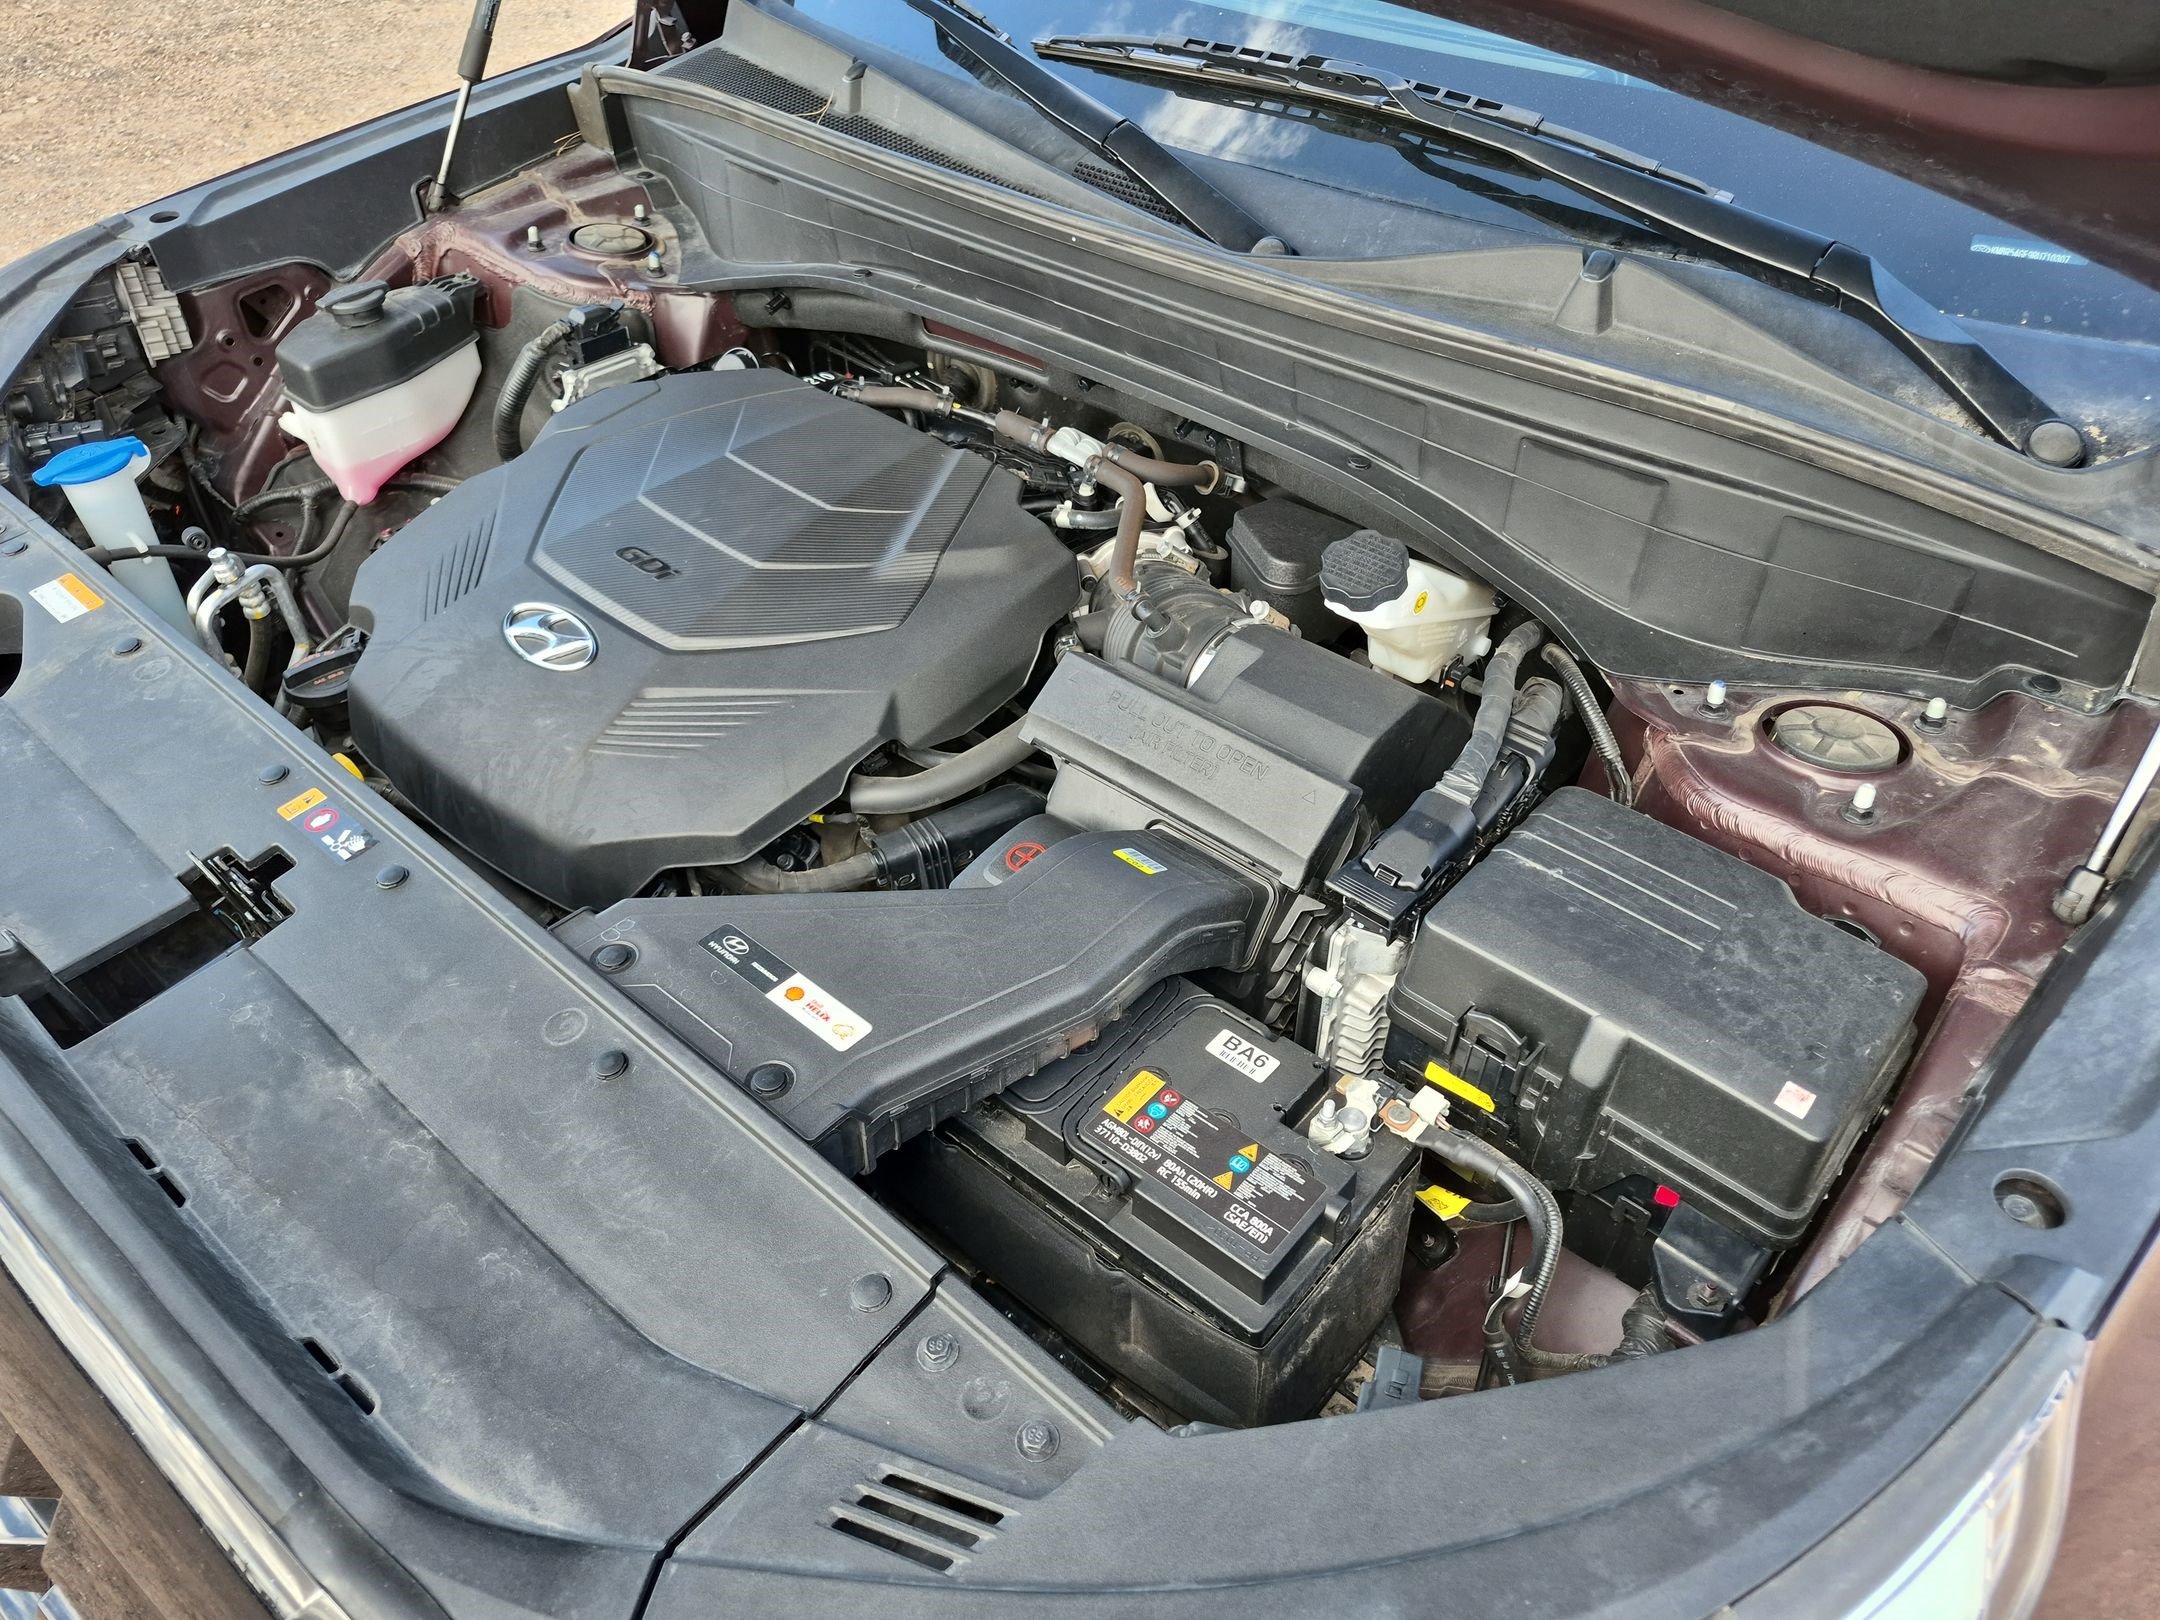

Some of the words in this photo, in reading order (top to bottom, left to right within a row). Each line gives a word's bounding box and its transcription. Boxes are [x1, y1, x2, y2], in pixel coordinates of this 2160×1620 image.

[615, 546, 681, 580] GDi
[1109, 689, 1146, 722] PULL
[1151, 712, 1192, 739] OUT
[1190, 729, 1217, 753] TO
[1216, 743, 1269, 781] OPEN
[708, 940, 740, 965] HYUNDAI
[1222, 1035, 1269, 1067] BA6
[1094, 1124, 1148, 1164] 37110-D3802
[1156, 1165, 1172, 1179] RC
[1170, 1174, 1201, 1200] 155min
[1163, 1158, 1186, 1178] 80Ah
[1187, 1174, 1218, 1198] (20HR)
[1229, 1203, 1250, 1220] CCA
[1249, 1216, 1274, 1237] 800A
